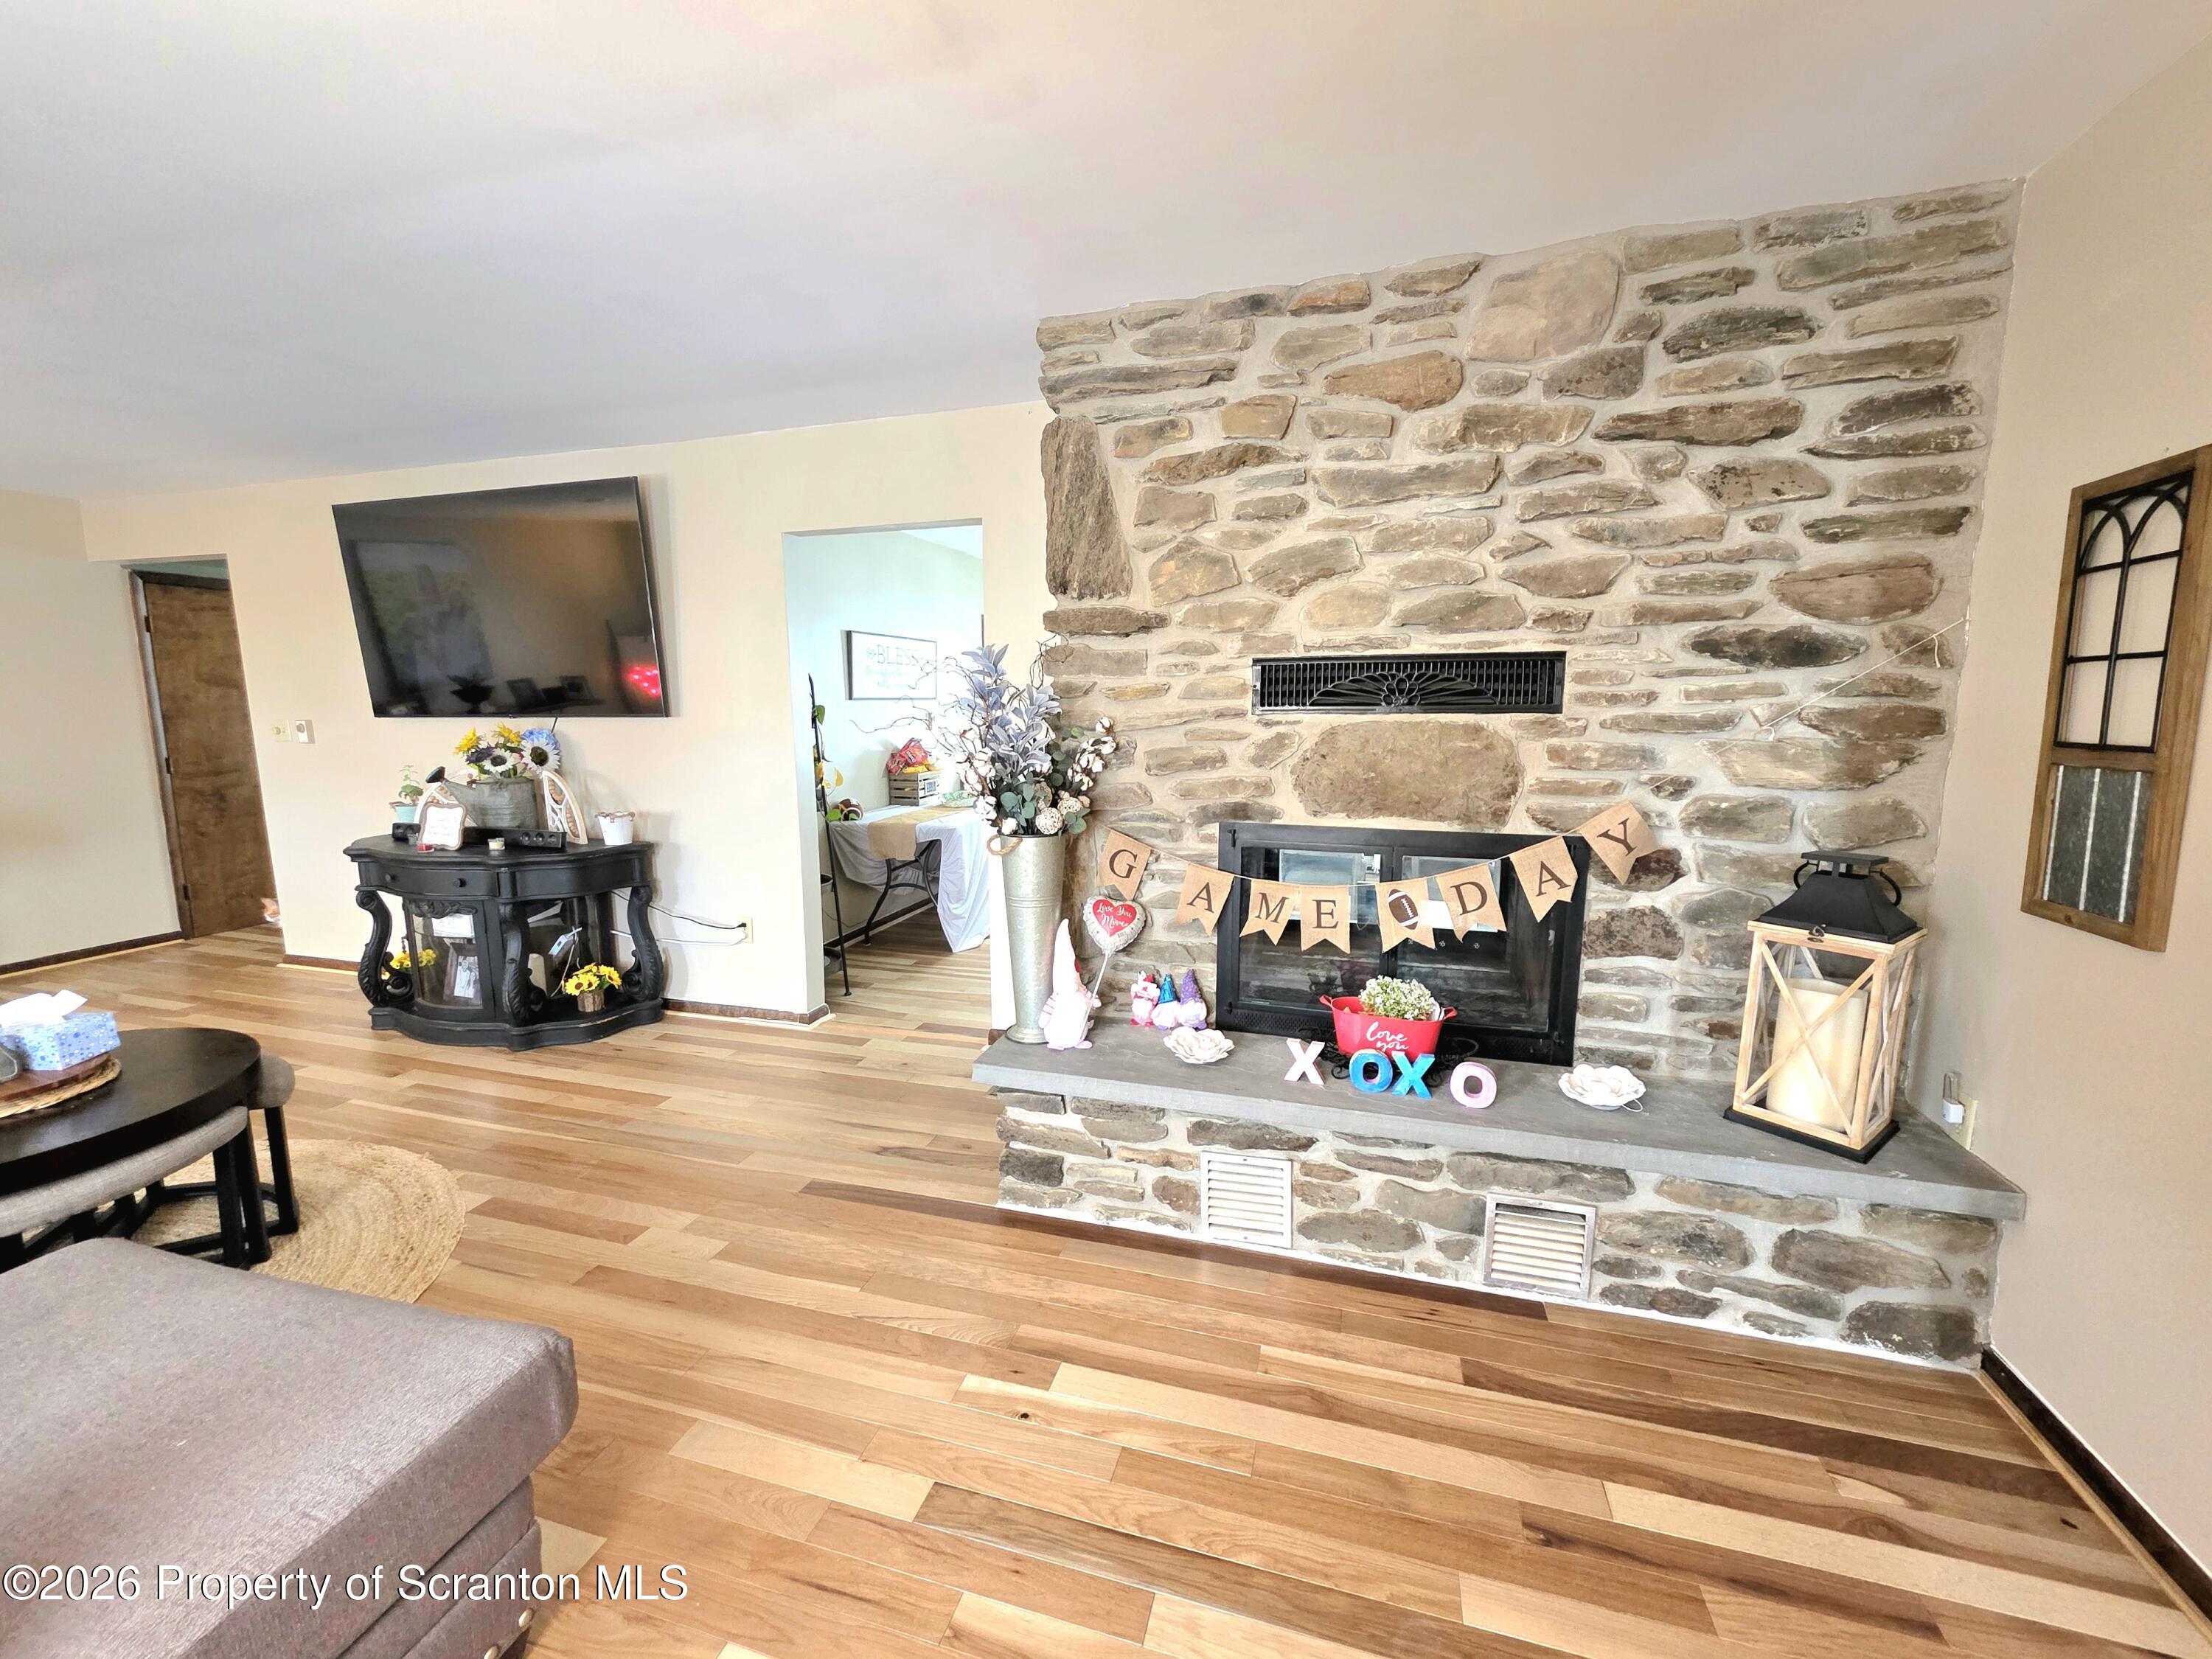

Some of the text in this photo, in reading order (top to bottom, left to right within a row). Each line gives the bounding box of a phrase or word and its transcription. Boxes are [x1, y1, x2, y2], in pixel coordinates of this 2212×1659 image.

[1109, 818, 1637, 929] GAME DAY
[1096, 902, 1133, 918] Love You
[1101, 913, 1129, 929] More
[1366, 1021, 1408, 1042] love
[1375, 1040, 1409, 1052] you
[1284, 1037, 1498, 1109] XOXO
